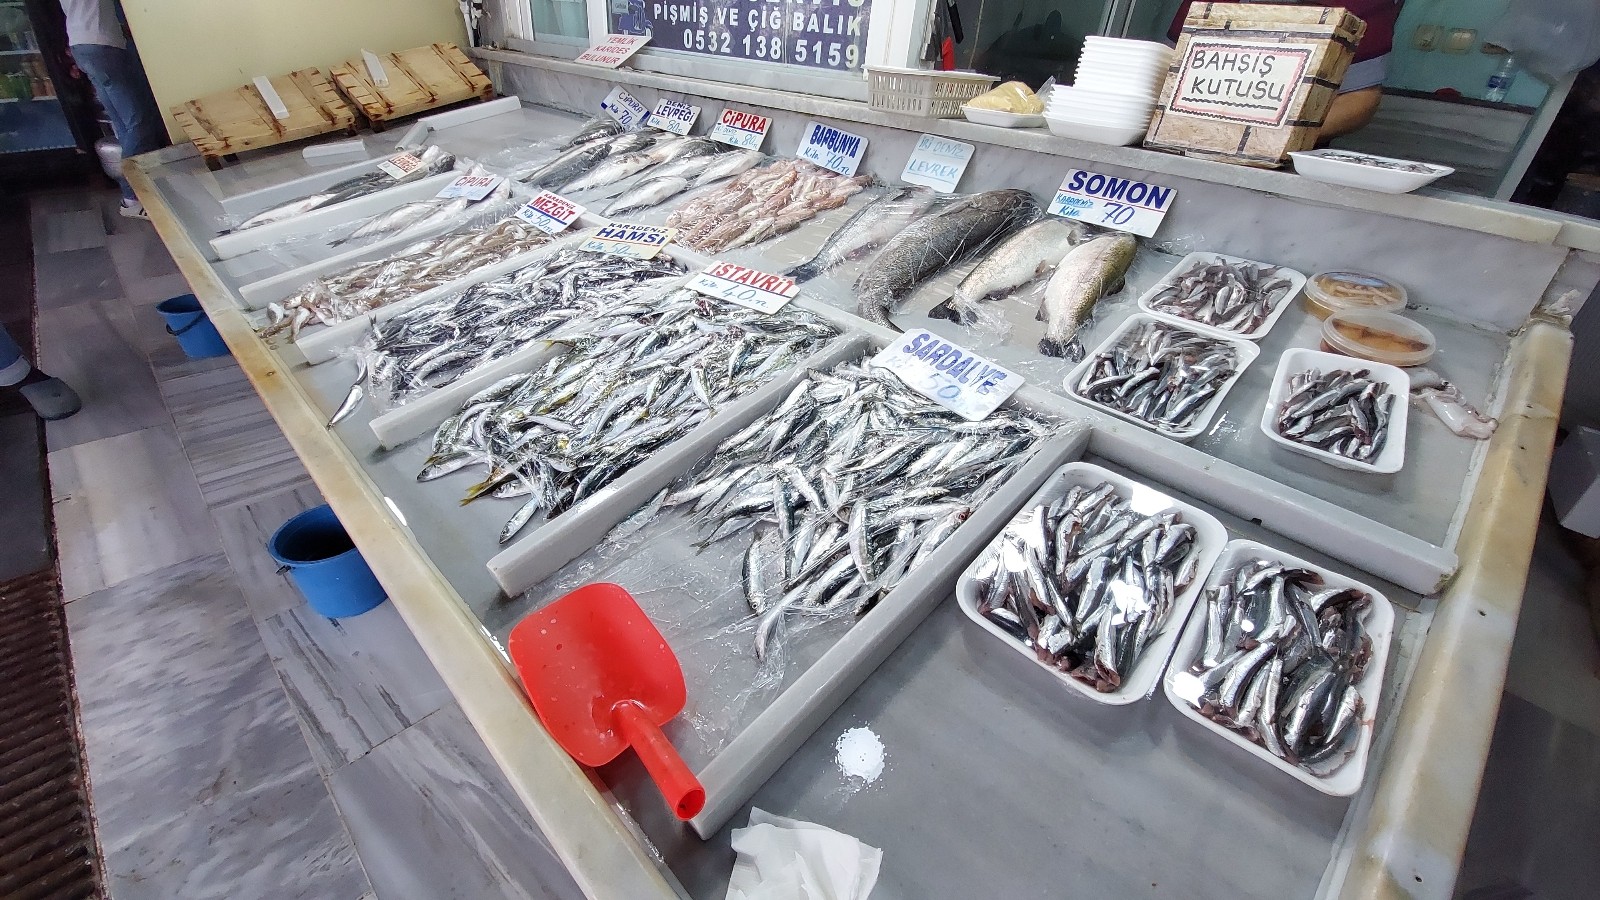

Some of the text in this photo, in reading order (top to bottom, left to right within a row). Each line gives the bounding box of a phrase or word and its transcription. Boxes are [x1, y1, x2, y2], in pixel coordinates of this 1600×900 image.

[653, 3, 862, 37] PİŞMİŞ VE ÇİĞ BALIK
[594, 45, 631, 55] KARİDES
[608, 36, 639, 46] YEMLİK
[684, 28, 858, 69] 0532 138 5159
[580, 53, 621, 64] BULUNUR
[1191, 50, 1276, 79] BAHŞİŞ
[1190, 76, 1286, 103] KUTUSU
[618, 109, 633, 125] 70
[722, 110, 767, 132] CİPURA
[809, 124, 861, 158] BARBUNYA
[908, 158, 959, 179] LEVREK
[1068, 170, 1172, 210] SOMON
[530, 196, 576, 221] MEZGİT
[1100, 201, 1136, 225] 70
[595, 227, 669, 245] HAMSİ
[607, 222, 669, 234] KARADENİZ
[708, 261, 796, 295] İSTAVRİT
[902, 333, 1008, 396] SARDALYE
